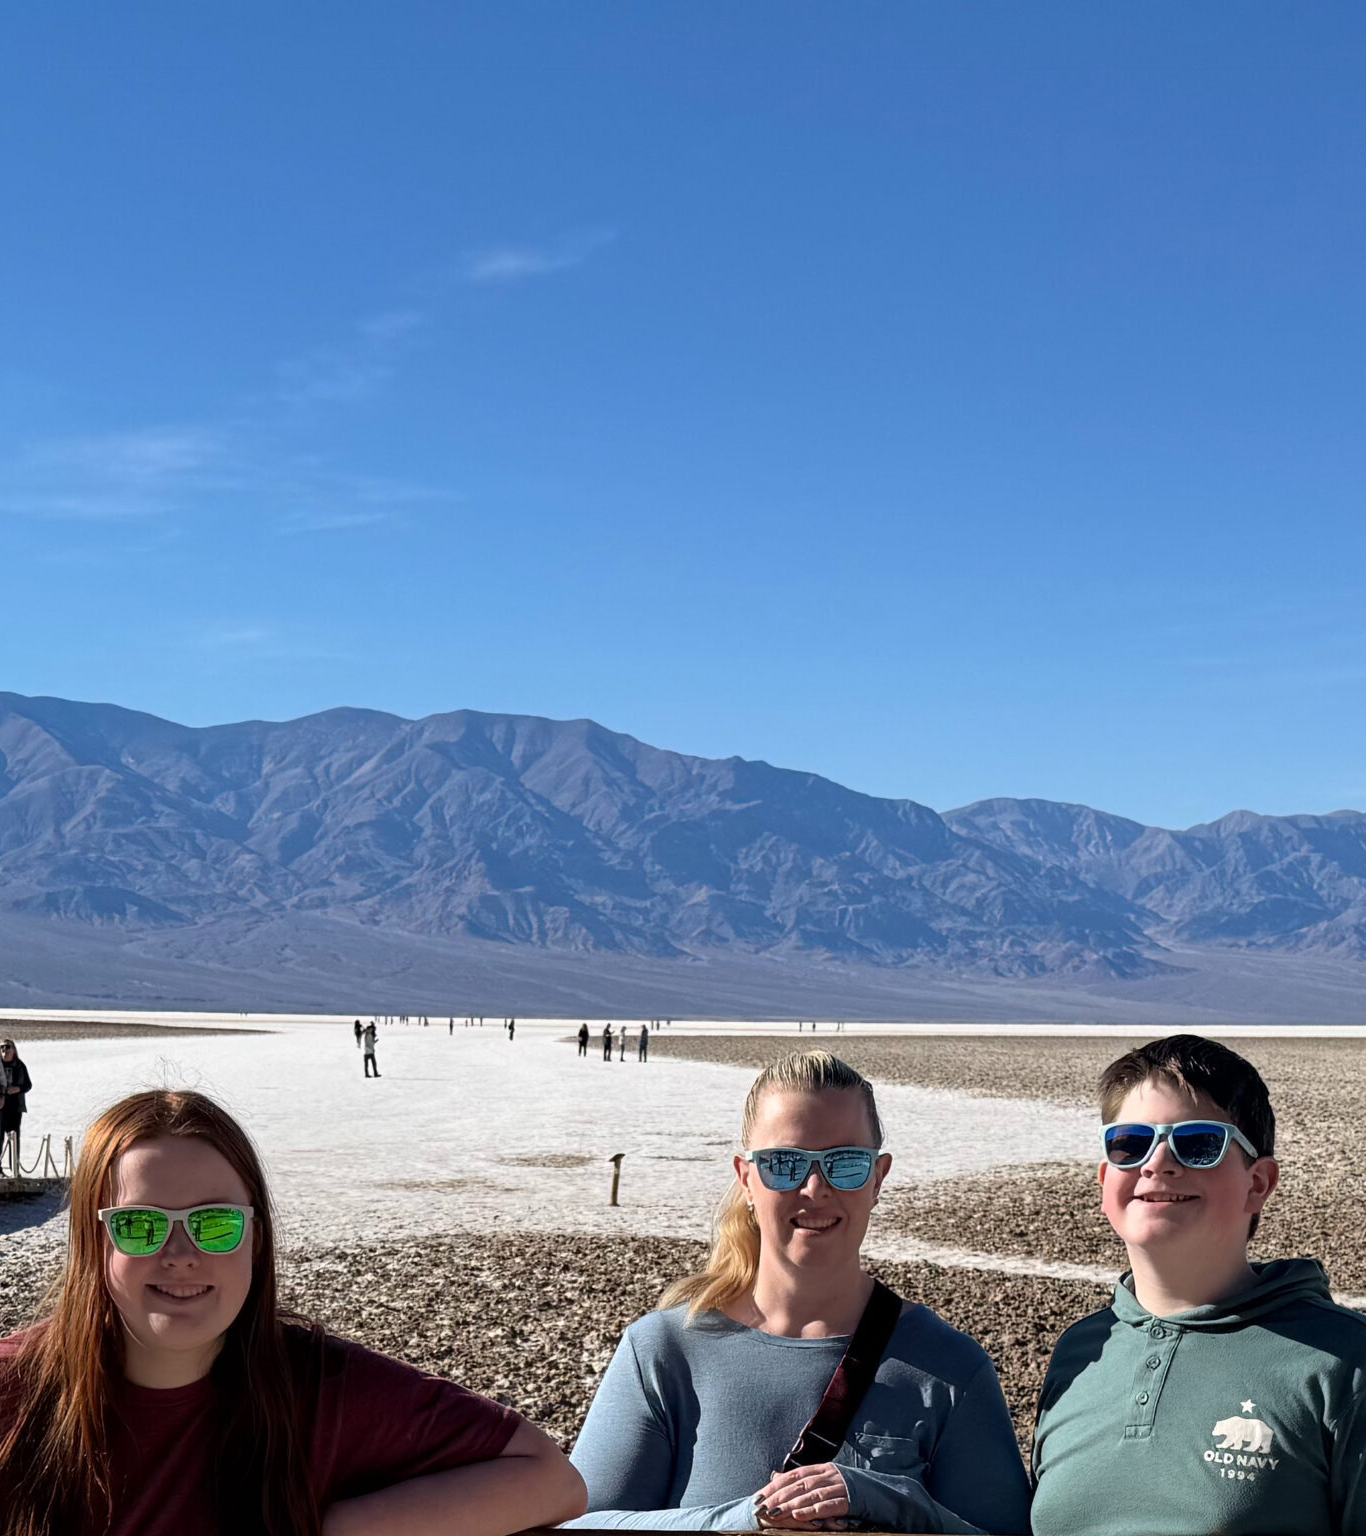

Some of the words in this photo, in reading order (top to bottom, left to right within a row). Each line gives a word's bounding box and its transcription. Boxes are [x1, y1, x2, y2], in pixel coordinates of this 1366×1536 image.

[1204, 1450, 1234, 1464] OLD
[1236, 1454, 1280, 1470] NAVY
[1220, 1467, 1255, 1481] 1994
